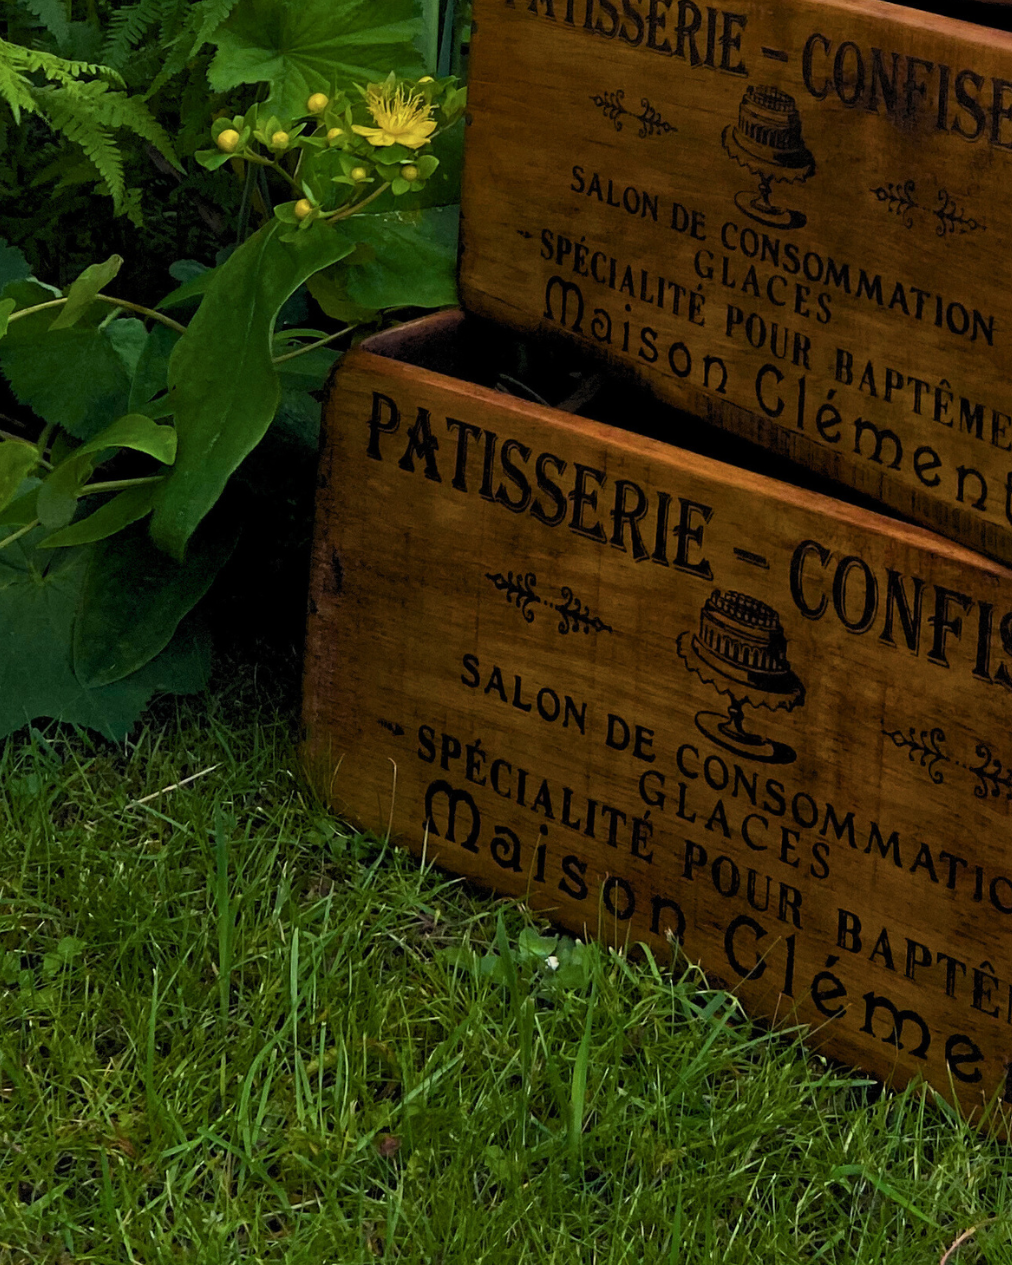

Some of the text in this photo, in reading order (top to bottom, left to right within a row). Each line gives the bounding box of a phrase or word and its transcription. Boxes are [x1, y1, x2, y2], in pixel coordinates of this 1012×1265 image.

[540, 228, 706, 328] SPÉCIALITÉ
[725, 304, 812, 371] POUR
[570, 165, 996, 347] SALON DE CONSOMMATION
[693, 249, 833, 325] GLACES
[543, 274, 727, 395] Maison
[366, 391, 714, 581] PATISSERIE
[461, 653, 588, 734] SALON
[604, 713, 657, 764] DE
[417, 723, 654, 864] SPÉCIALITÉ
[682, 838, 803, 931] POUR
[421, 778, 686, 946] Maison
[638, 770, 831, 880] GLACES
